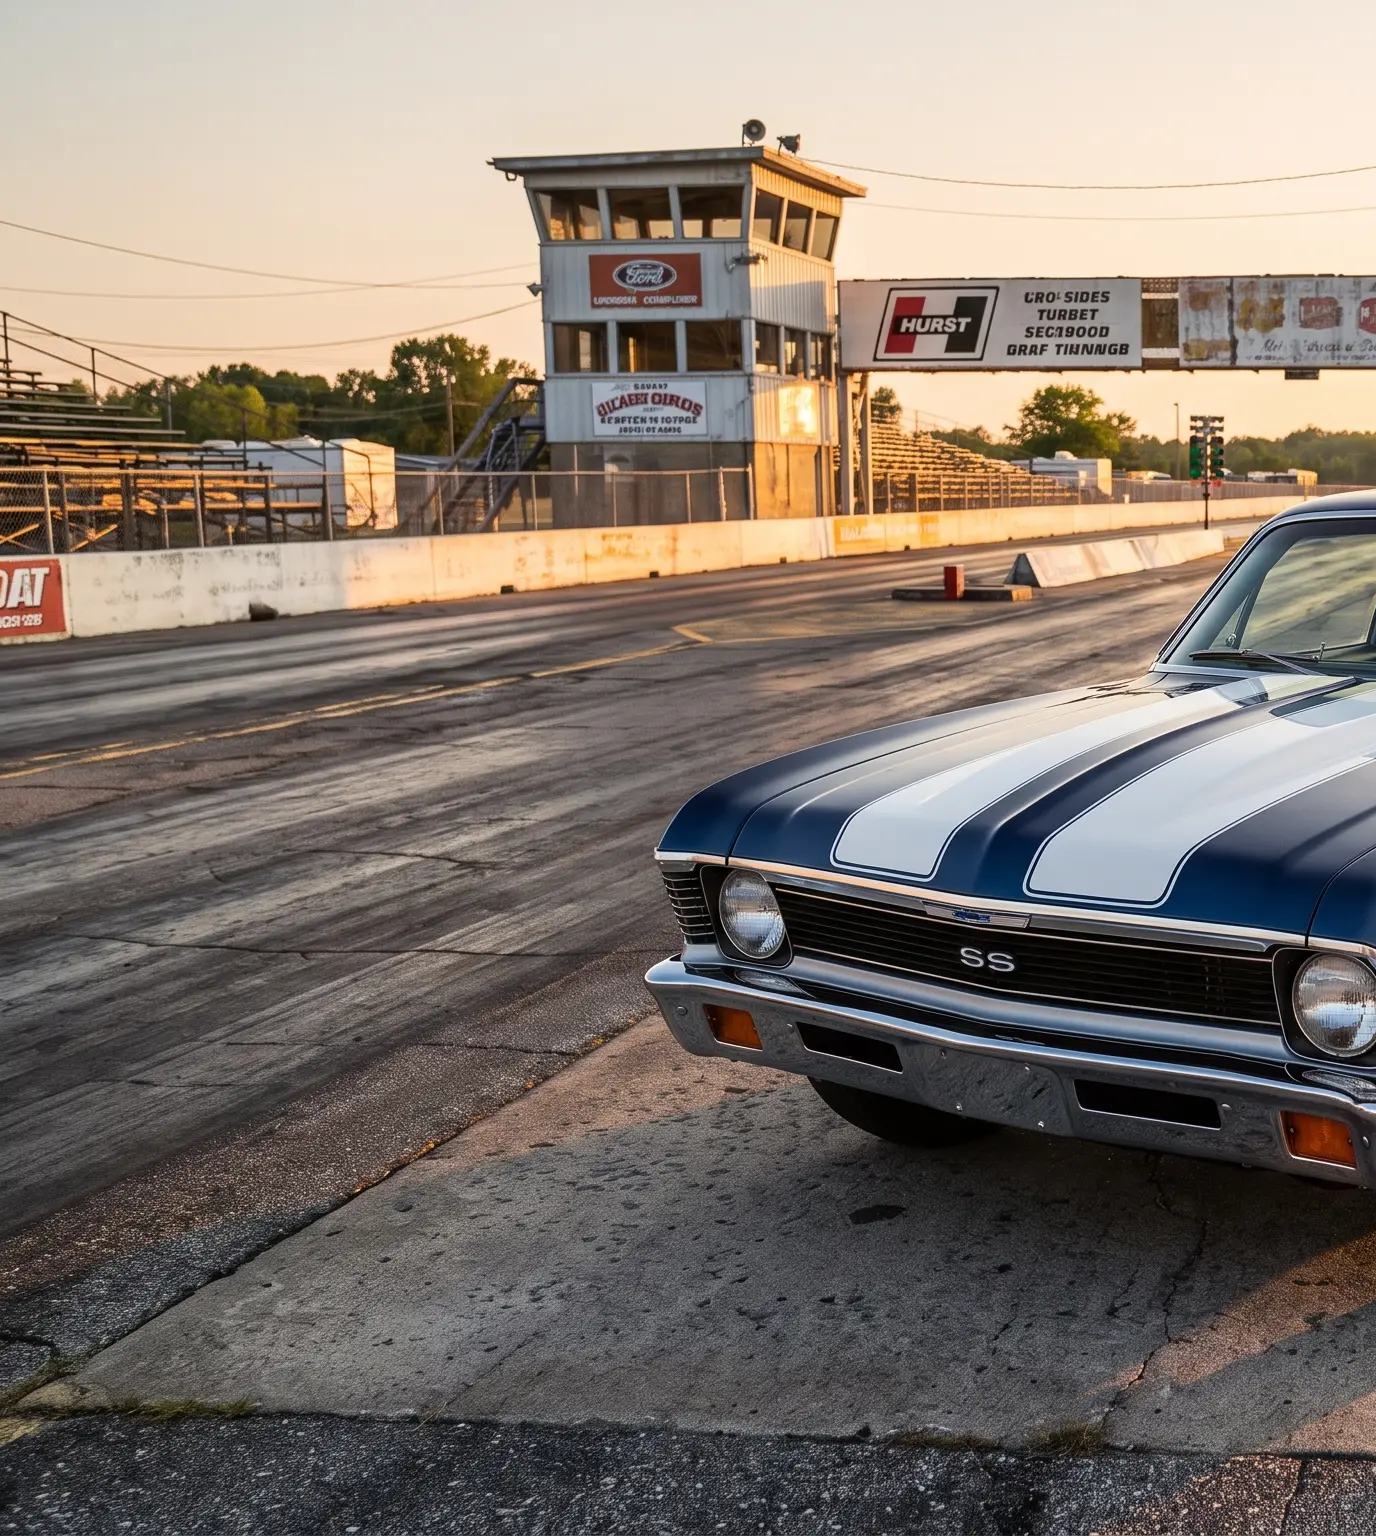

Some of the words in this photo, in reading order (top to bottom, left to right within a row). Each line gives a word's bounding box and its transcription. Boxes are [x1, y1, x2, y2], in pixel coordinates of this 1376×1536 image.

[1063, 291, 1111, 303] SIDES
[1037, 308, 1099, 321] TURBET
[900, 317, 972, 333] HURST
[960, 947, 1016, 972] SS
